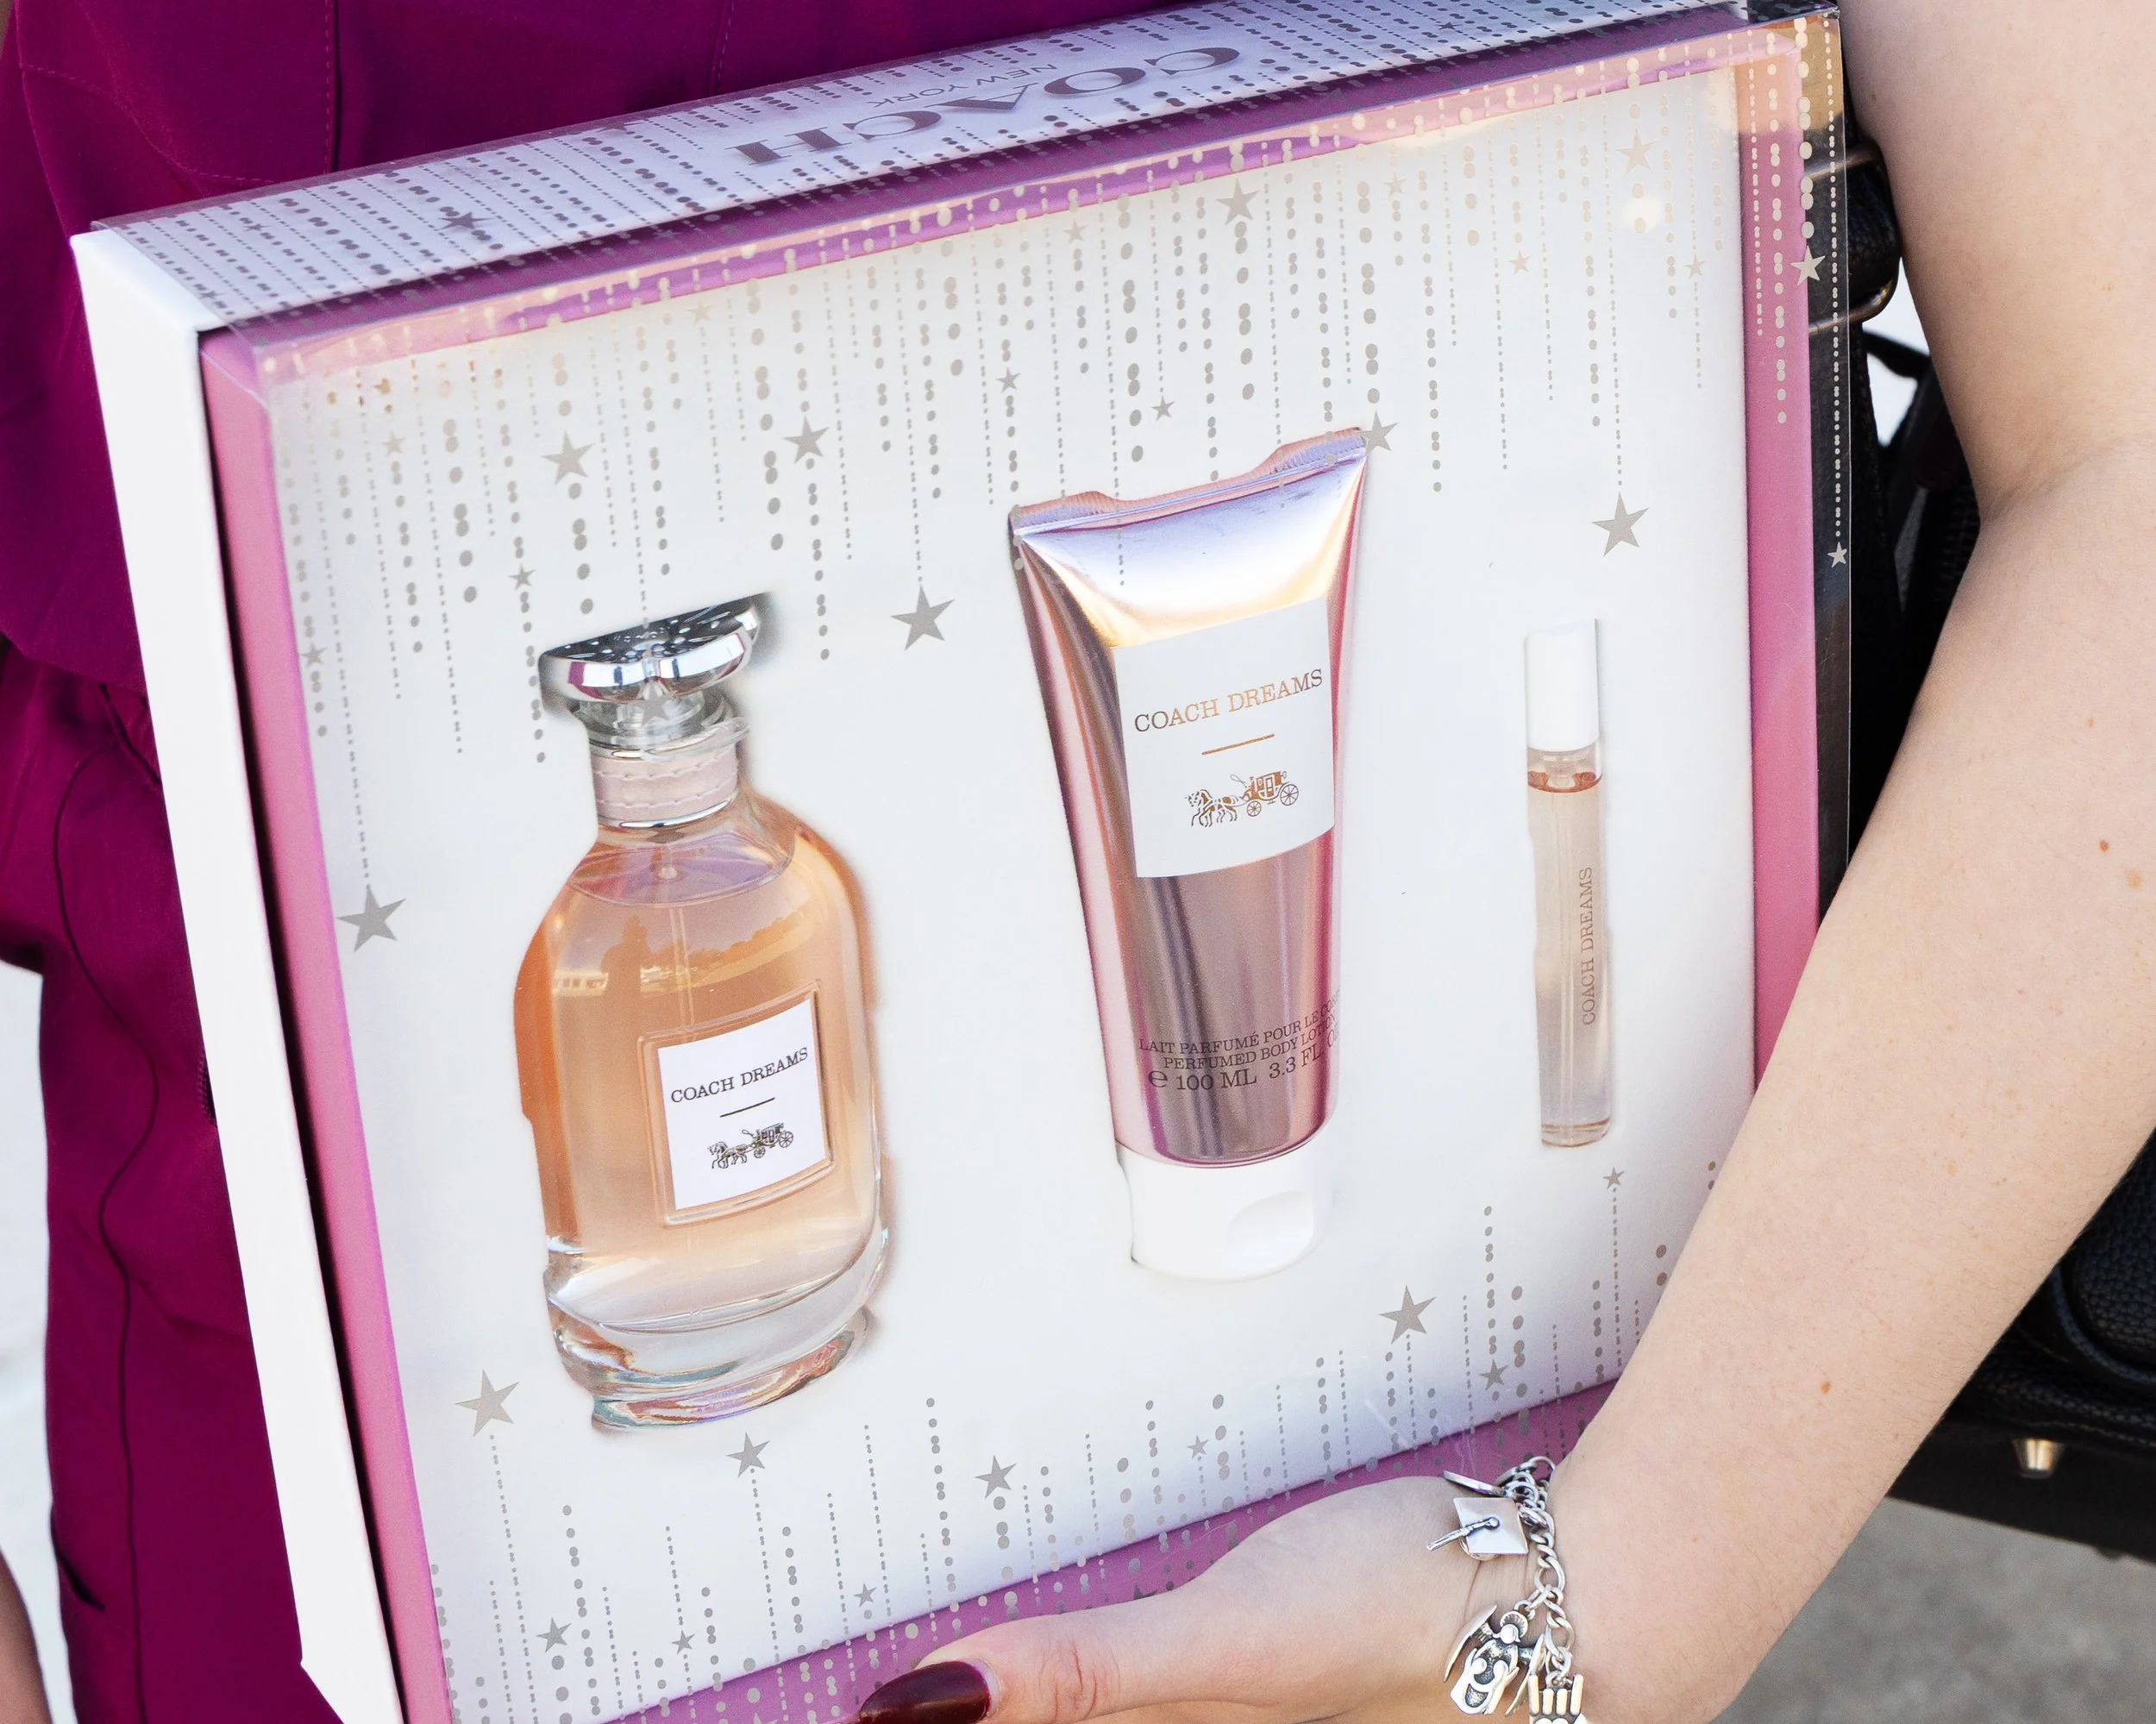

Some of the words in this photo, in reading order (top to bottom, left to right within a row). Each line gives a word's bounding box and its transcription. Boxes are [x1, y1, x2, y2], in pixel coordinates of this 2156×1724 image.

[867, 84, 968, 108] YORK
[976, 64, 1057, 86] NEW
[724, 47, 1240, 166] COACH
[1134, 699, 1219, 732] COACH
[1226, 668, 1323, 712] DREAMS
[1578, 867, 1594, 952] DREAMS
[1580, 957, 1596, 1025] COACH
[1138, 1038, 1175, 1054] LAIT
[1180, 1032, 1259, 1055] PARFUMÉ
[1263, 1020, 1301, 1044] POUR
[1304, 1010, 1319, 1028] LE
[1163, 1051, 1257, 1069] PERFUMED
[1260, 1037, 1298, 1061] BODY
[671, 1077, 735, 1103] COACH
[740, 1047, 808, 1087] DREAMS
[1176, 1075, 1214, 1091] 100
[1220, 1069, 1257, 1089] ML
[1269, 1056, 1296, 1080] 3.3
